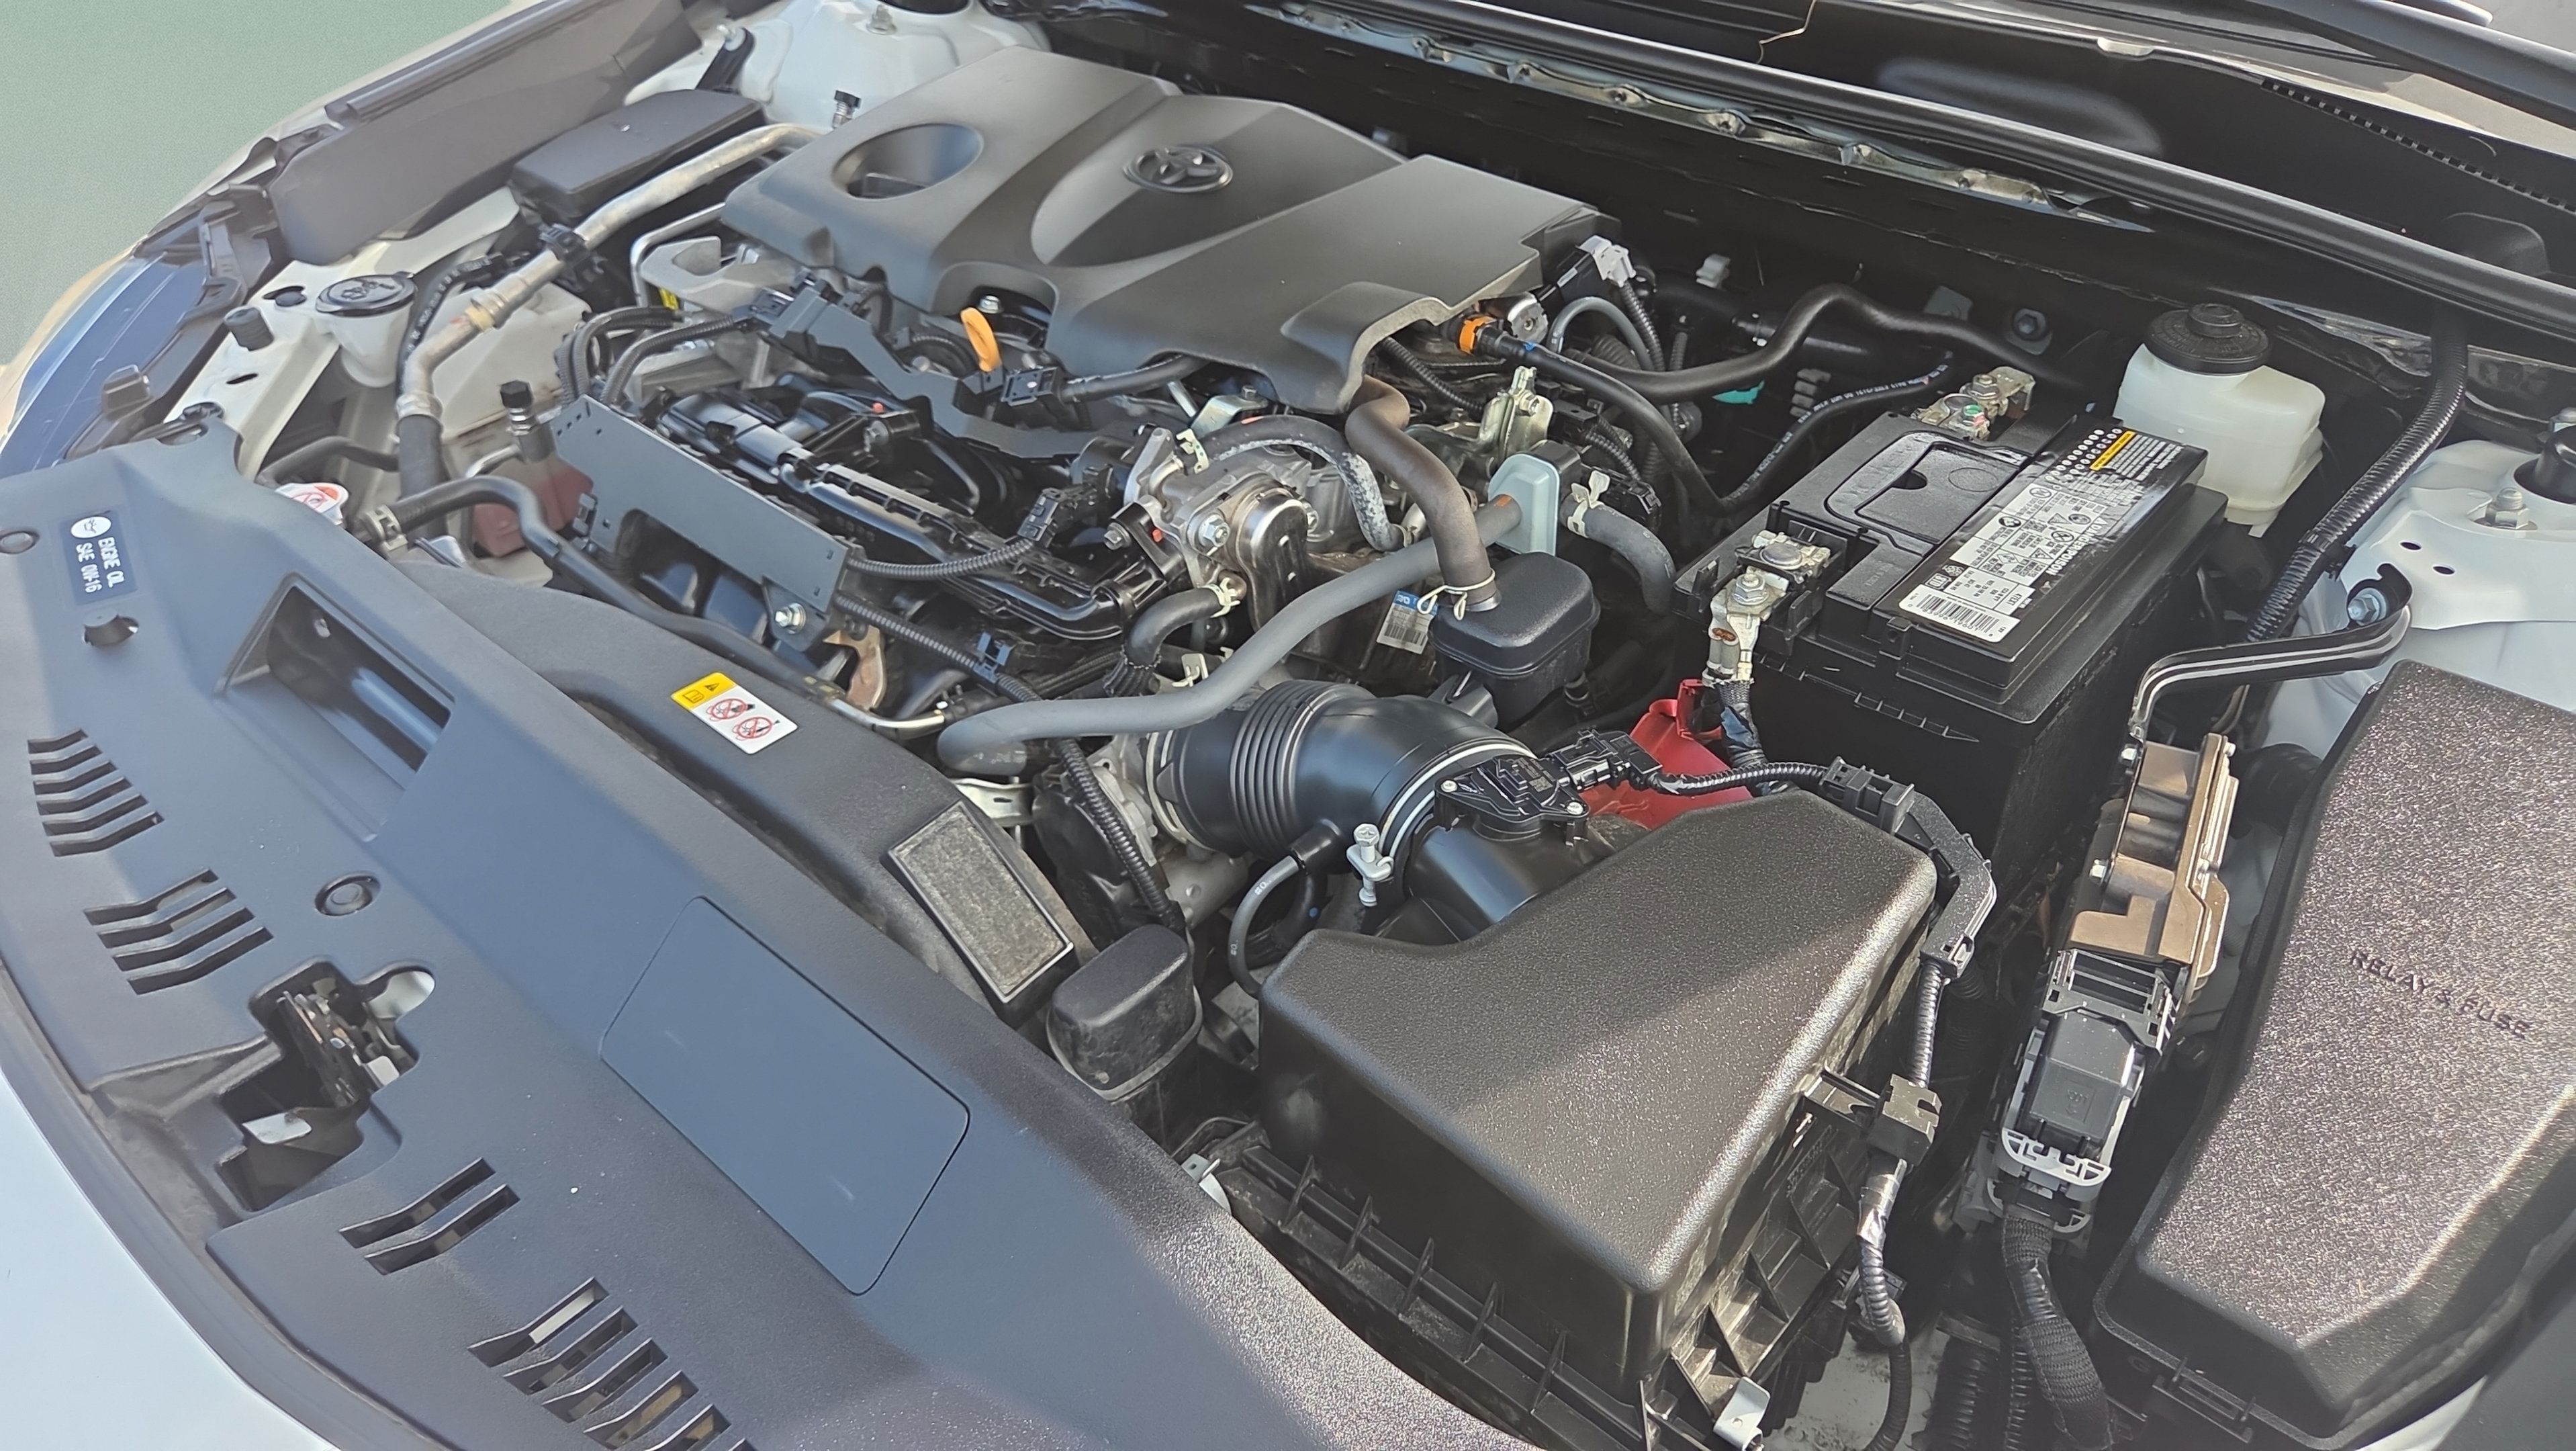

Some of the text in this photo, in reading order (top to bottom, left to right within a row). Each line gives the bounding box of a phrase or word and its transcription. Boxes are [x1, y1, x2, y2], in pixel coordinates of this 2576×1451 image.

[75, 542, 95, 563] SAE
[105, 570, 125, 588] OIL
[2350, 949, 2435, 994] RELAY
[2458, 994, 2534, 1041] FUSE
